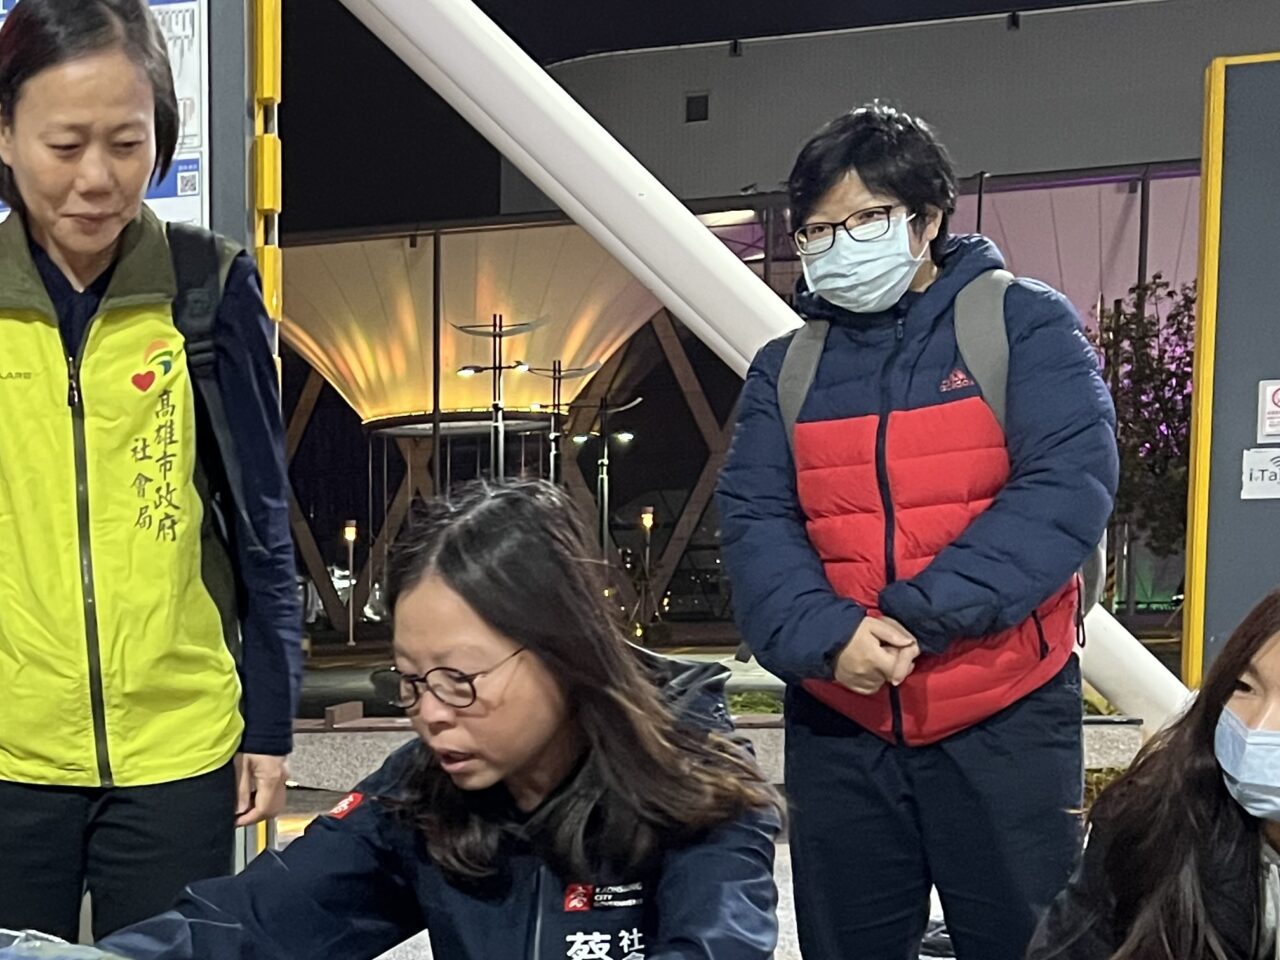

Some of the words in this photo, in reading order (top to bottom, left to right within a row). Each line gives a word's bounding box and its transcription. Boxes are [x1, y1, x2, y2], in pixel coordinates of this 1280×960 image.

[130, 437, 154, 531] 社會局
[153, 389, 181, 543] 高雄市政府
